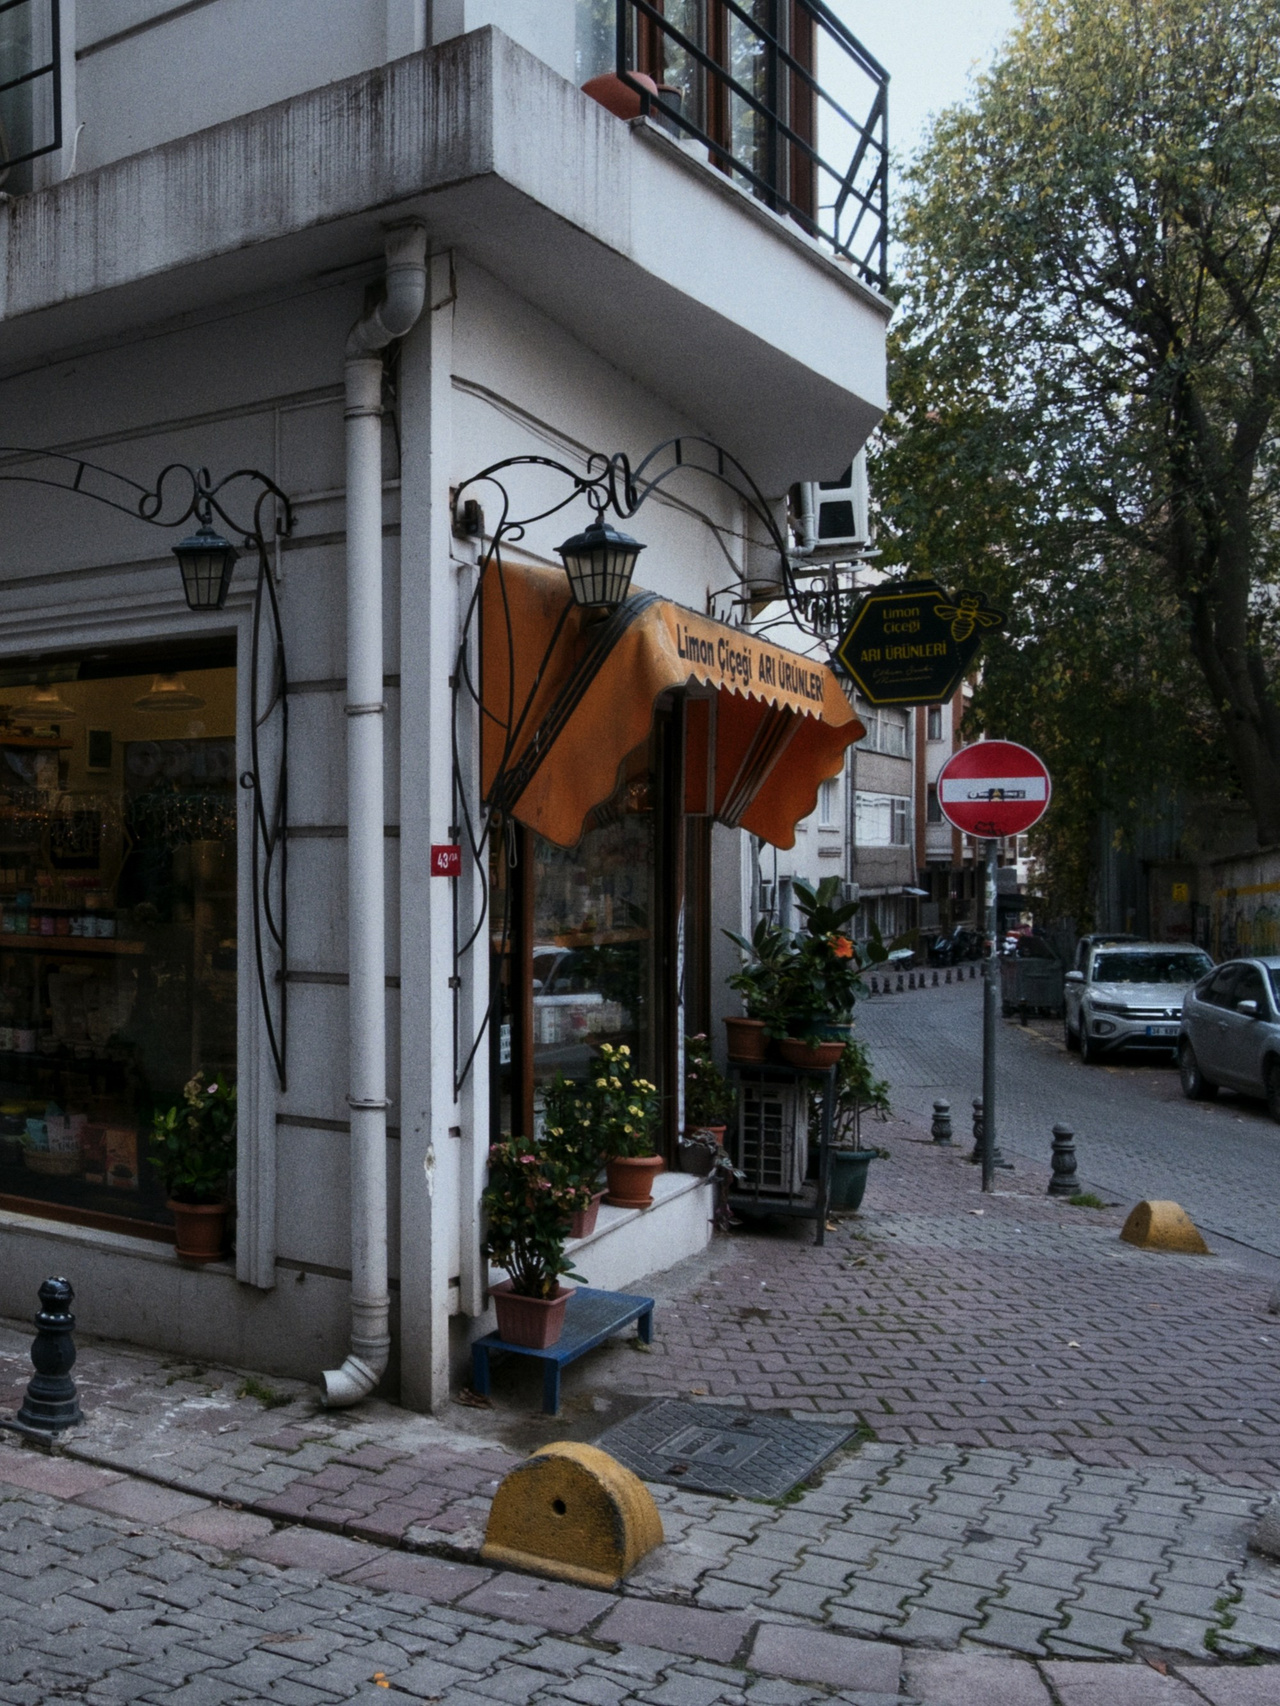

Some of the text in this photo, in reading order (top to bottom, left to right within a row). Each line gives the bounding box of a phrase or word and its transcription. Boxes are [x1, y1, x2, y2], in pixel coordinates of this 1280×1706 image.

[883, 607, 920, 620] Limon
[676, 623, 825, 702] Limon Çiçeği ARI ÜRÜNLERİ
[860, 640, 947, 663] ARI ÜRÜNLERİ
